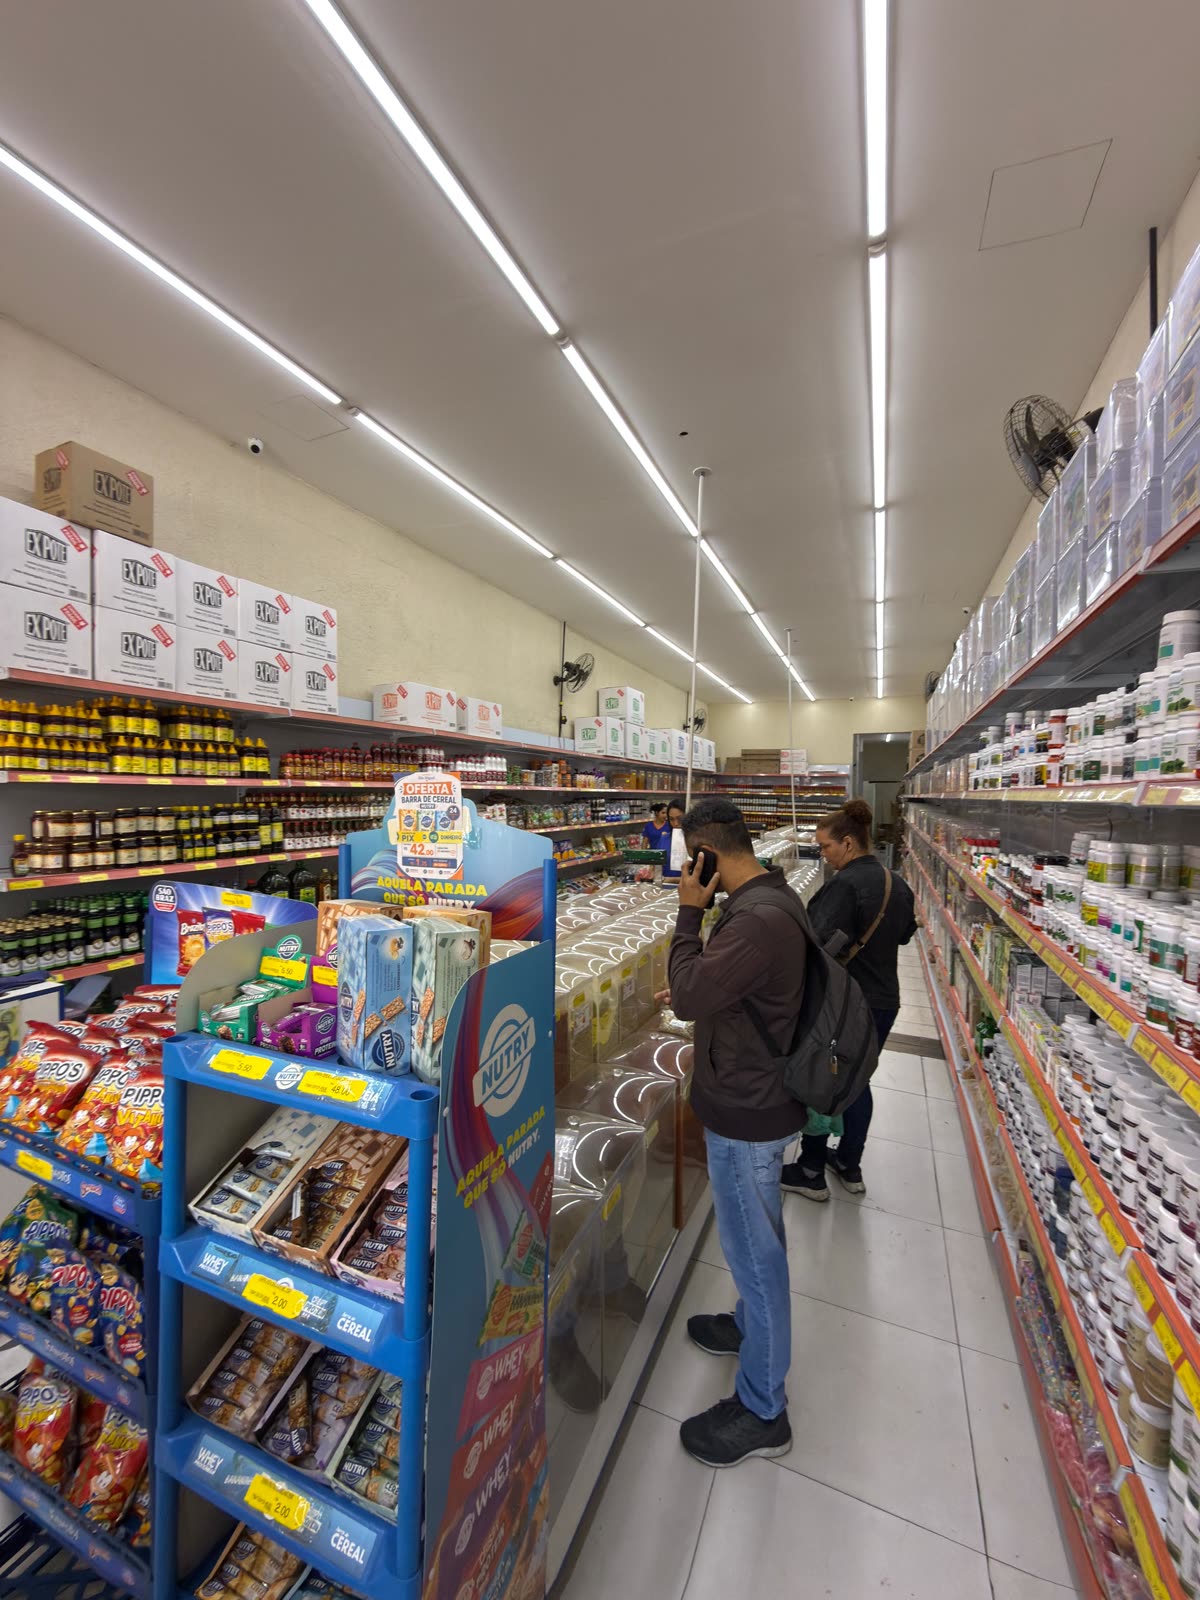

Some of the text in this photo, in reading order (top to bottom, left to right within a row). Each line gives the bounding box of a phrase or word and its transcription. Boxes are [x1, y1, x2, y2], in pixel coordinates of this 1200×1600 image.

[406, 783, 450, 794] OFERTA
[401, 795, 456, 804] BARRA DE CEREAL
[377, 876, 488, 897] AQUELA PARADA
[383, 892, 405, 906] QUE
[408, 893, 426, 906] SÓ
[278, 944, 300, 953] NUTRY
[381, 1032, 396, 1069] NUTRY
[481, 1023, 532, 1097] NUTRY
[278, 1072, 301, 1081] NUTRY
[456, 1143, 505, 1197] AQUELA
[506, 1105, 545, 1150] PARADA
[464, 1176, 489, 1209] QUE
[273, 1228, 293, 1238] NUTR
[381, 1228, 406, 1239] NUTRY
[363, 1240, 389, 1252] NUTRY
[202, 1252, 229, 1272] WHEY
[350, 1258, 378, 1269] NUTRY
[336, 1317, 372, 1343] CEREAL
[494, 1343, 526, 1381] WHEY
[483, 1393, 518, 1452] WHEY
[198, 1446, 224, 1471] WHEY
[342, 1461, 369, 1477] NUTRY
[384, 1480, 400, 1496] CERE
[476, 1444, 512, 1517] WHEY
[330, 1532, 366, 1566] CEREAL
